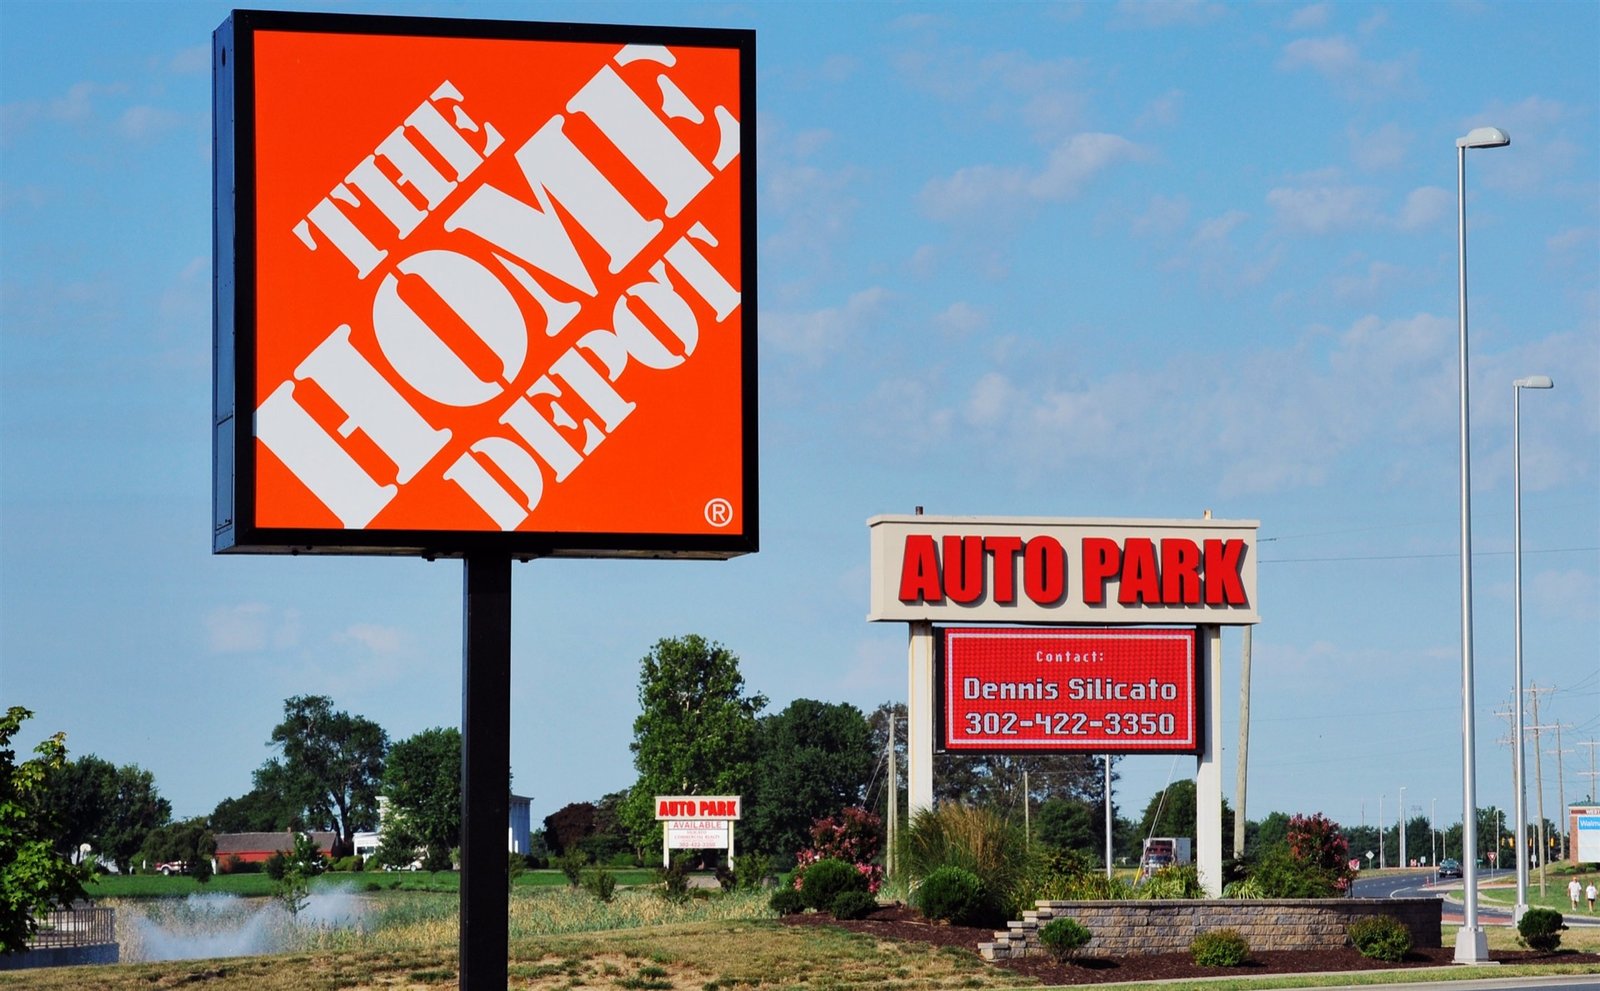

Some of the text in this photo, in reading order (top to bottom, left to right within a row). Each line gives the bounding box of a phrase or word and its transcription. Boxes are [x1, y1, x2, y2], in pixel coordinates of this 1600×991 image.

[292, 80, 505, 280] THE
[253, 43, 740, 530] HOME
[443, 221, 741, 532] DEPOT
[898, 534, 1249, 607] AUTO PARK
[1035, 650, 1105, 663] Contact:
[962, 677, 1178, 701] Dennis Silicato
[964, 711, 1176, 736] 302-422-3350
[659, 801, 736, 816] AUTO PARK
[673, 821, 721, 829] AVAILABLE
